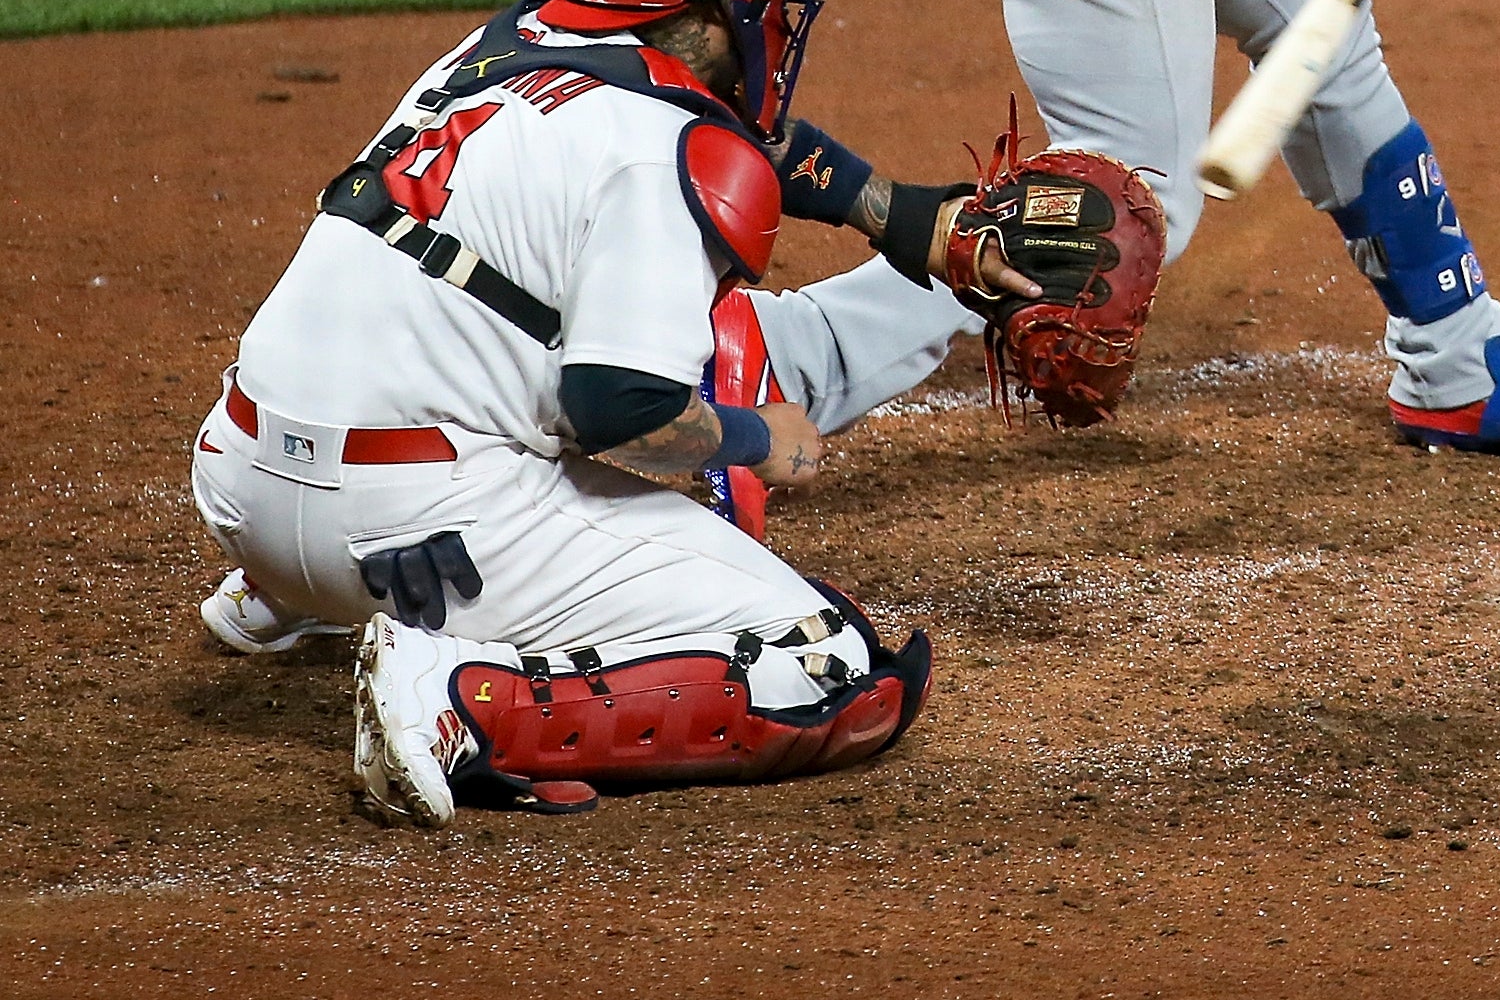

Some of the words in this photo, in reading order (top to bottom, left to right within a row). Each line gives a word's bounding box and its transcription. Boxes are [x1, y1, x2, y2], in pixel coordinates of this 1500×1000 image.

[381, 101, 505, 223] 4
[352, 178, 367, 198] 4
[820, 166, 833, 190] 4
[1398, 177, 1417, 200] 9
[1437, 268, 1457, 292] 9
[384, 622, 395, 650] AIR
